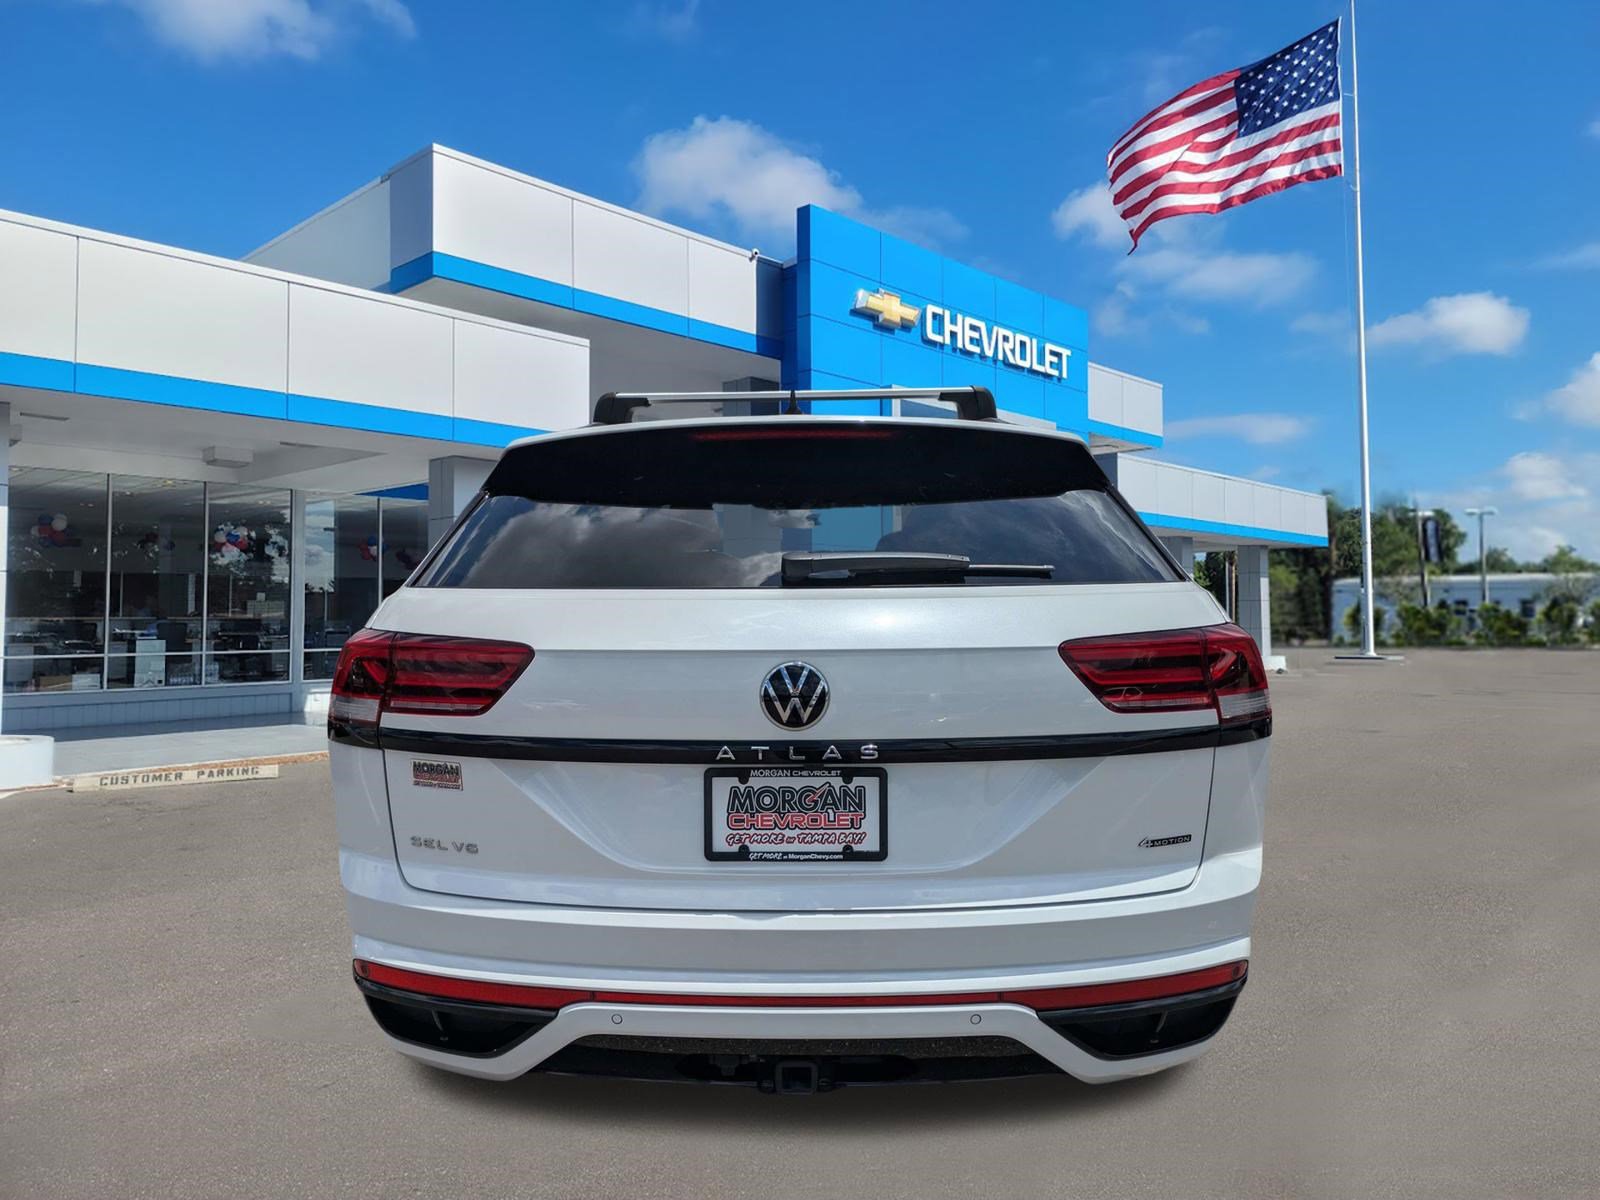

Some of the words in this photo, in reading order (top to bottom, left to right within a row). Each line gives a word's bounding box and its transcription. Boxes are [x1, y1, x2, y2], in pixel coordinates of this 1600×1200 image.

[924, 304, 1072, 379] CHEVROLET
[715, 744, 879, 760] ATLAS
[99, 772, 183, 786] CUSTOMER
[196, 766, 260, 779] PARKING
[750, 769, 791, 777] MORGAN
[728, 783, 867, 813] MORGAN
[728, 812, 866, 830] CHEVROLET
[410, 836, 449, 851] SEL
[451, 841, 479, 854] V6
[726, 833, 748, 846] GET
[750, 832, 785, 845] MORE
[796, 832, 837, 845] TAMPA
[837, 832, 867, 845] BAY!
[749, 852, 762, 861] GET
[762, 852, 783, 860] MORE
[788, 853, 844, 861] MorganChevy.com
